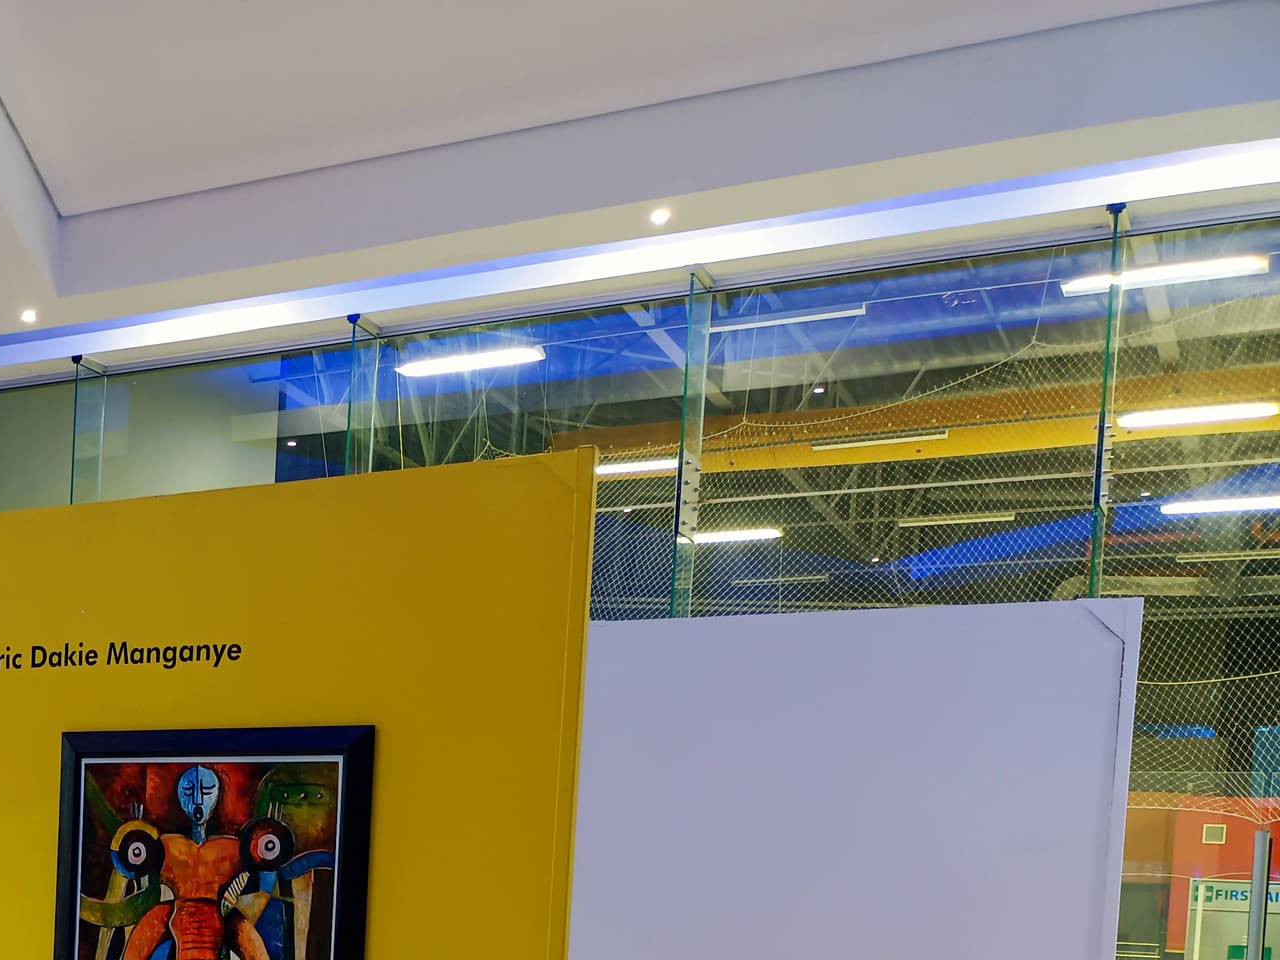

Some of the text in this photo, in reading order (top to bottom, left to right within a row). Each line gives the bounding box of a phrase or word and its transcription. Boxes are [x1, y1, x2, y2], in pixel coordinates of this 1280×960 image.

[30, 642, 99, 669] Dakie
[106, 641, 242, 669] Manganye
[1215, 889, 1280, 903] FIRS AI
